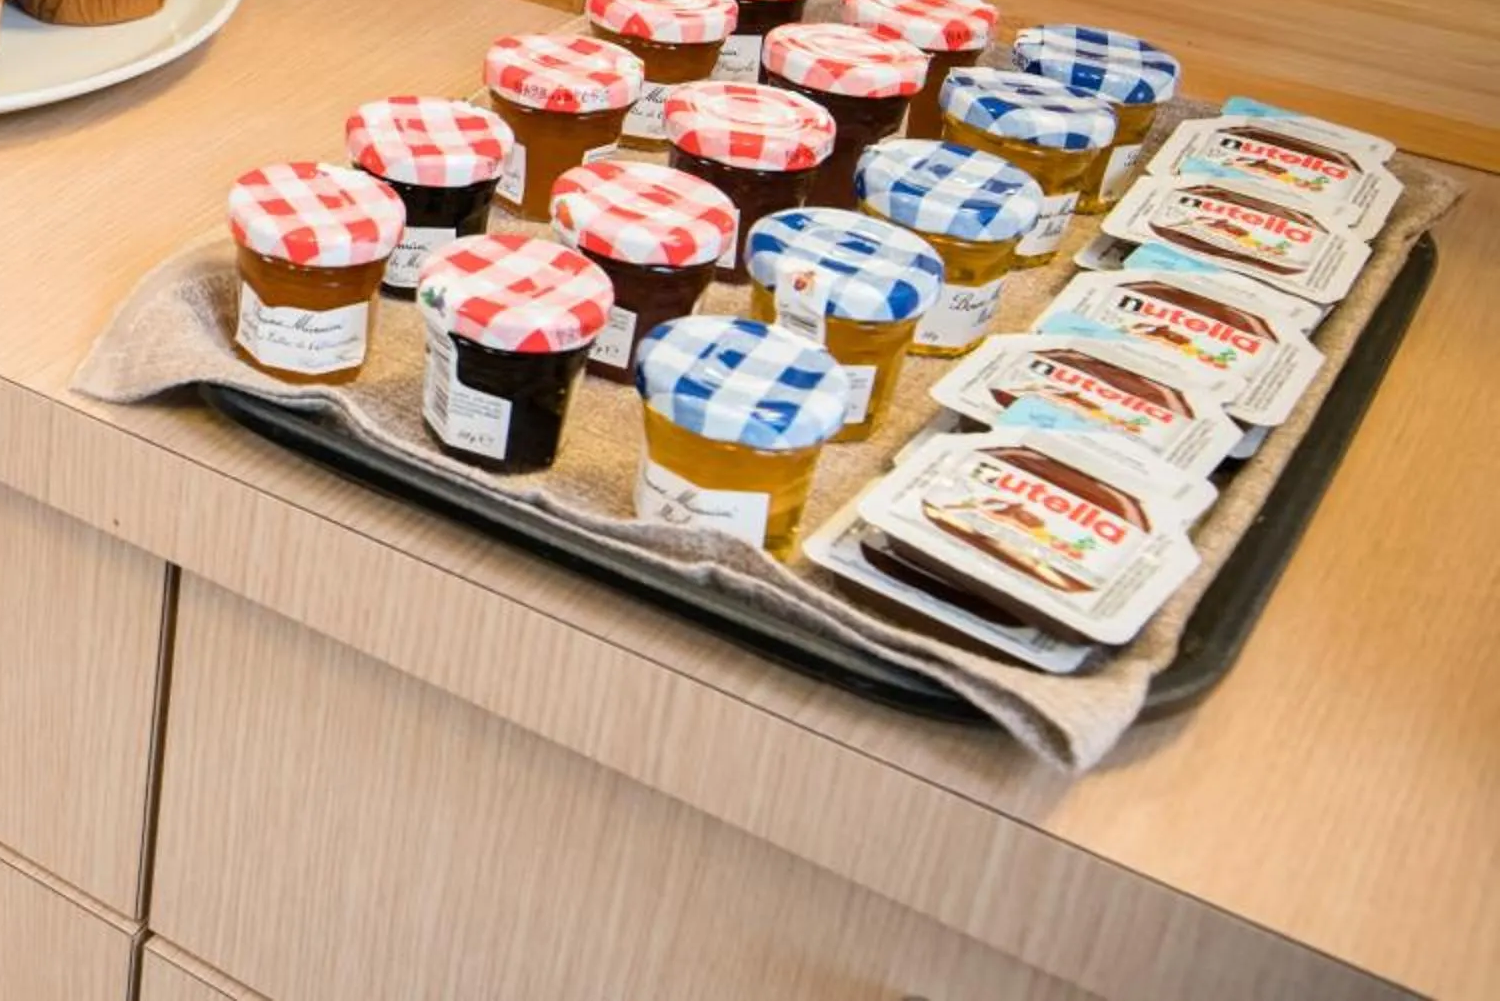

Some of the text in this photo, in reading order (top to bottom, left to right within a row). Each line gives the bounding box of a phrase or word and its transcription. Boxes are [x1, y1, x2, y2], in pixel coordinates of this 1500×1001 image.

[1219, 136, 1350, 182] nutella
[1178, 195, 1316, 246] nutella
[1116, 294, 1264, 356] nutella
[1028, 359, 1174, 426] nutella
[973, 461, 1127, 546] nutella
